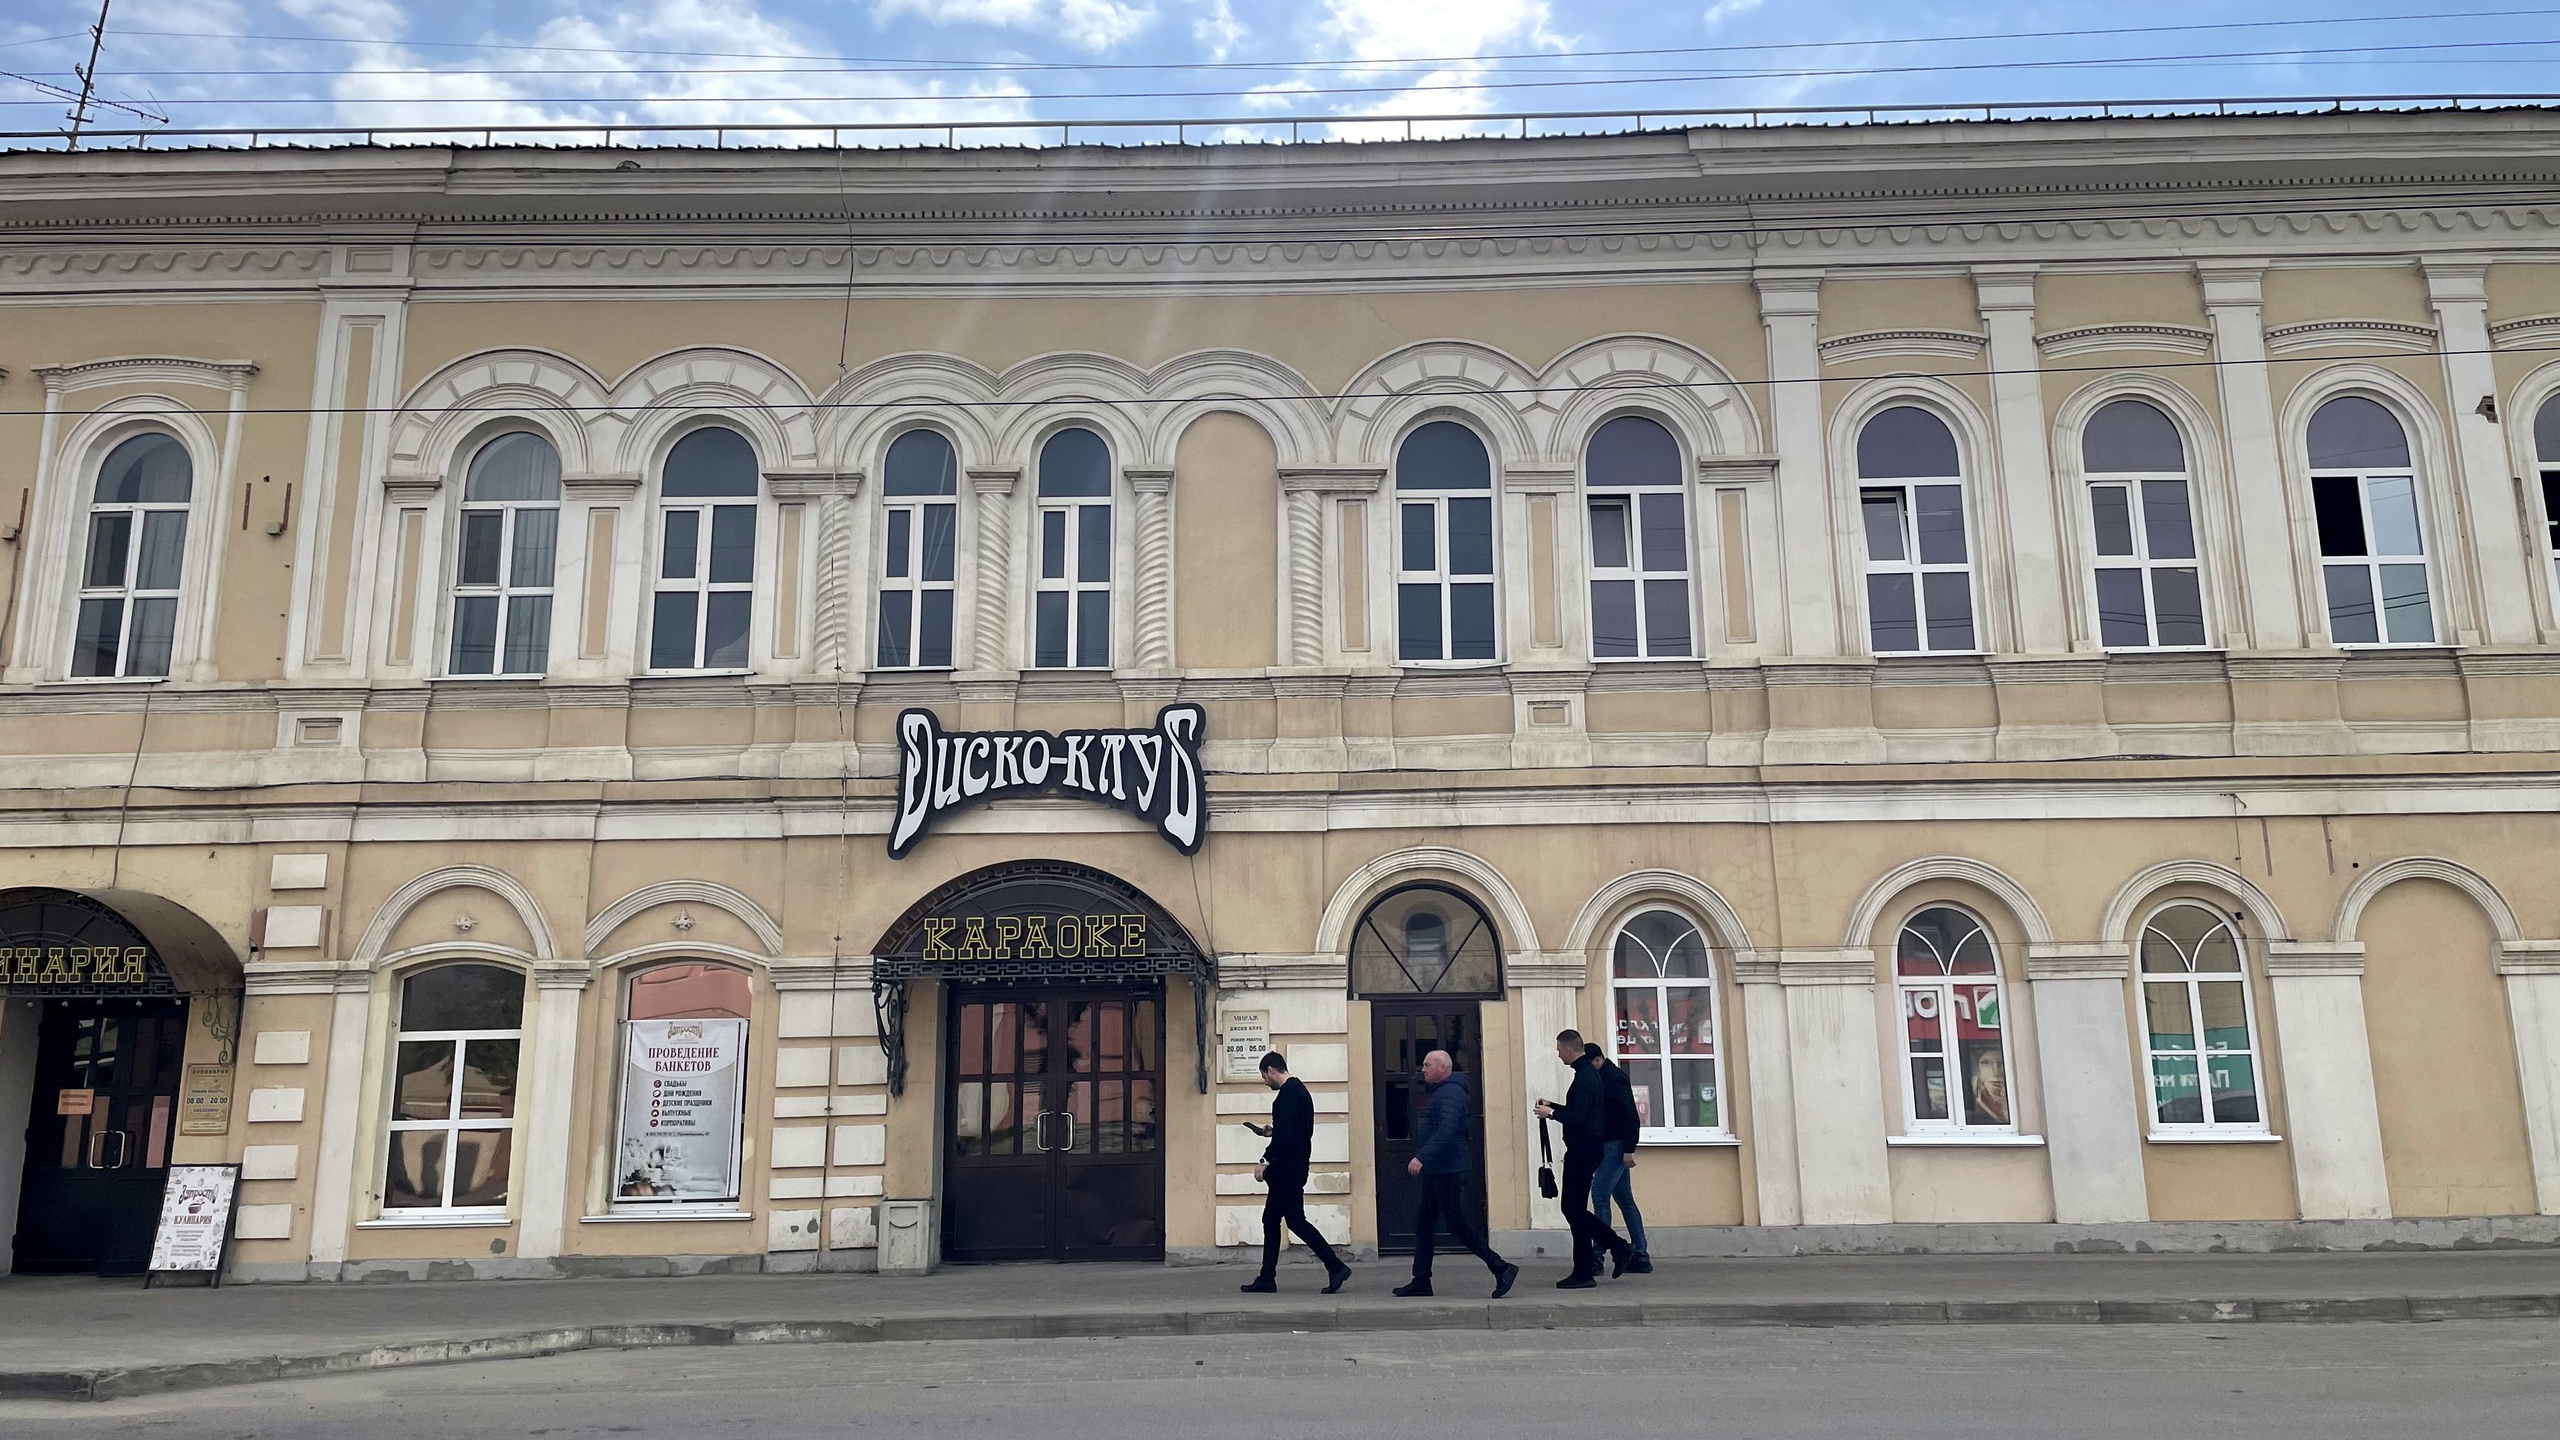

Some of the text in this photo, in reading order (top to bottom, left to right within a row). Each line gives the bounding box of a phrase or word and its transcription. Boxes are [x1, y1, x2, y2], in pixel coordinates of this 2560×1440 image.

[922, 914, 1147, 961] КАРАОКЕ
[648, 1047, 720, 1060] ПРОВЕДЕНИЕ
[1226, 1045, 1244, 1053] 20.00
[655, 1060, 711, 1072] БАНКЕТОВ
[173, 1215, 213, 1225] КУЛИНАРИЯ
